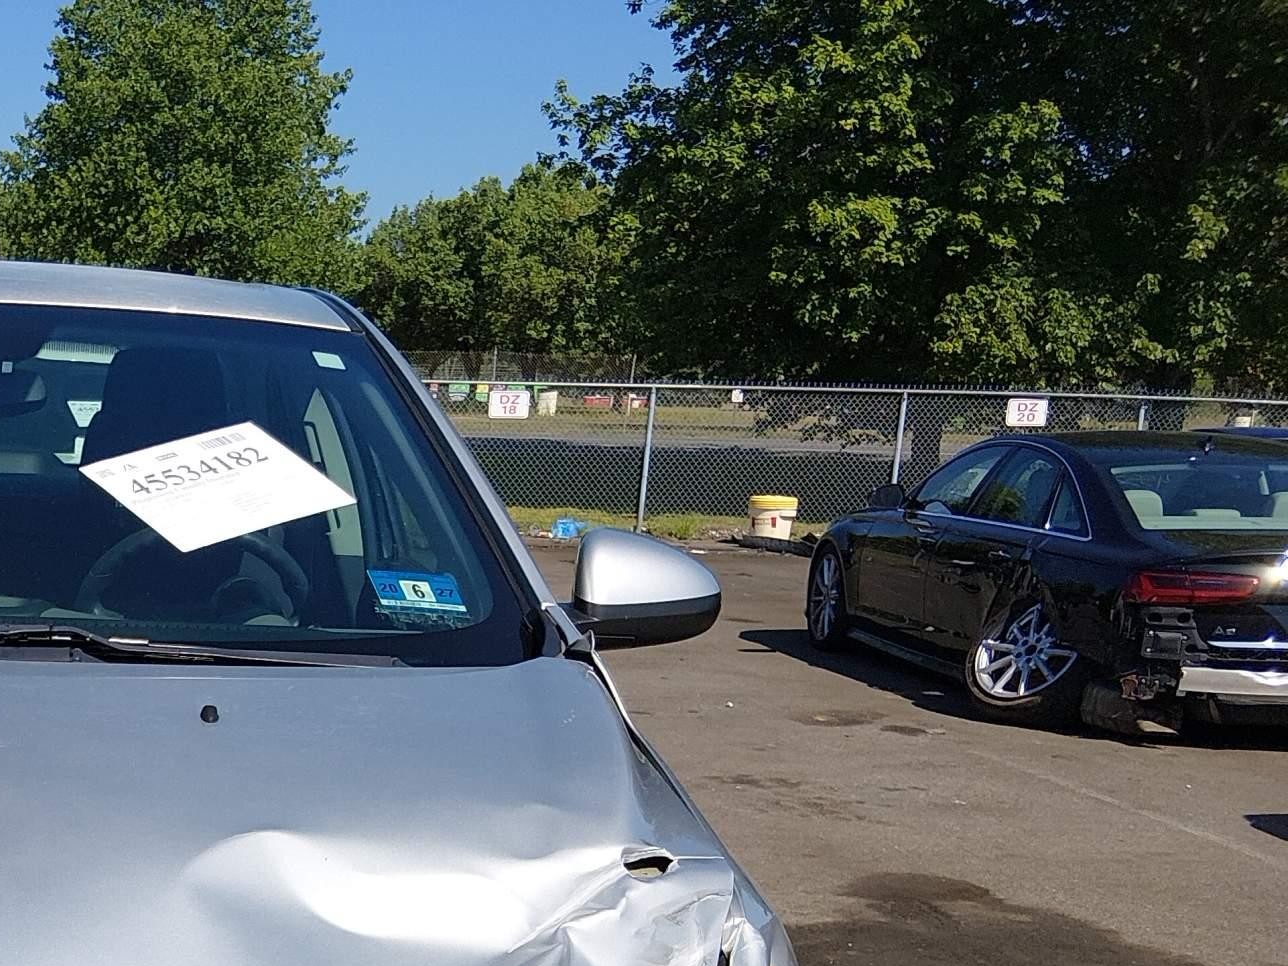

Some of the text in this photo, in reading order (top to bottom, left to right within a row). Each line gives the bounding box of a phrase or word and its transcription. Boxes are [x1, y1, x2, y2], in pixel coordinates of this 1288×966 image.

[499, 394, 521, 405] DZ
[502, 405, 517, 415] 18
[1017, 402, 1039, 412] DZ
[1016, 412, 1036, 422] 20
[131, 446, 269, 496] 45534182
[378, 583, 455, 599] 20 6 27
